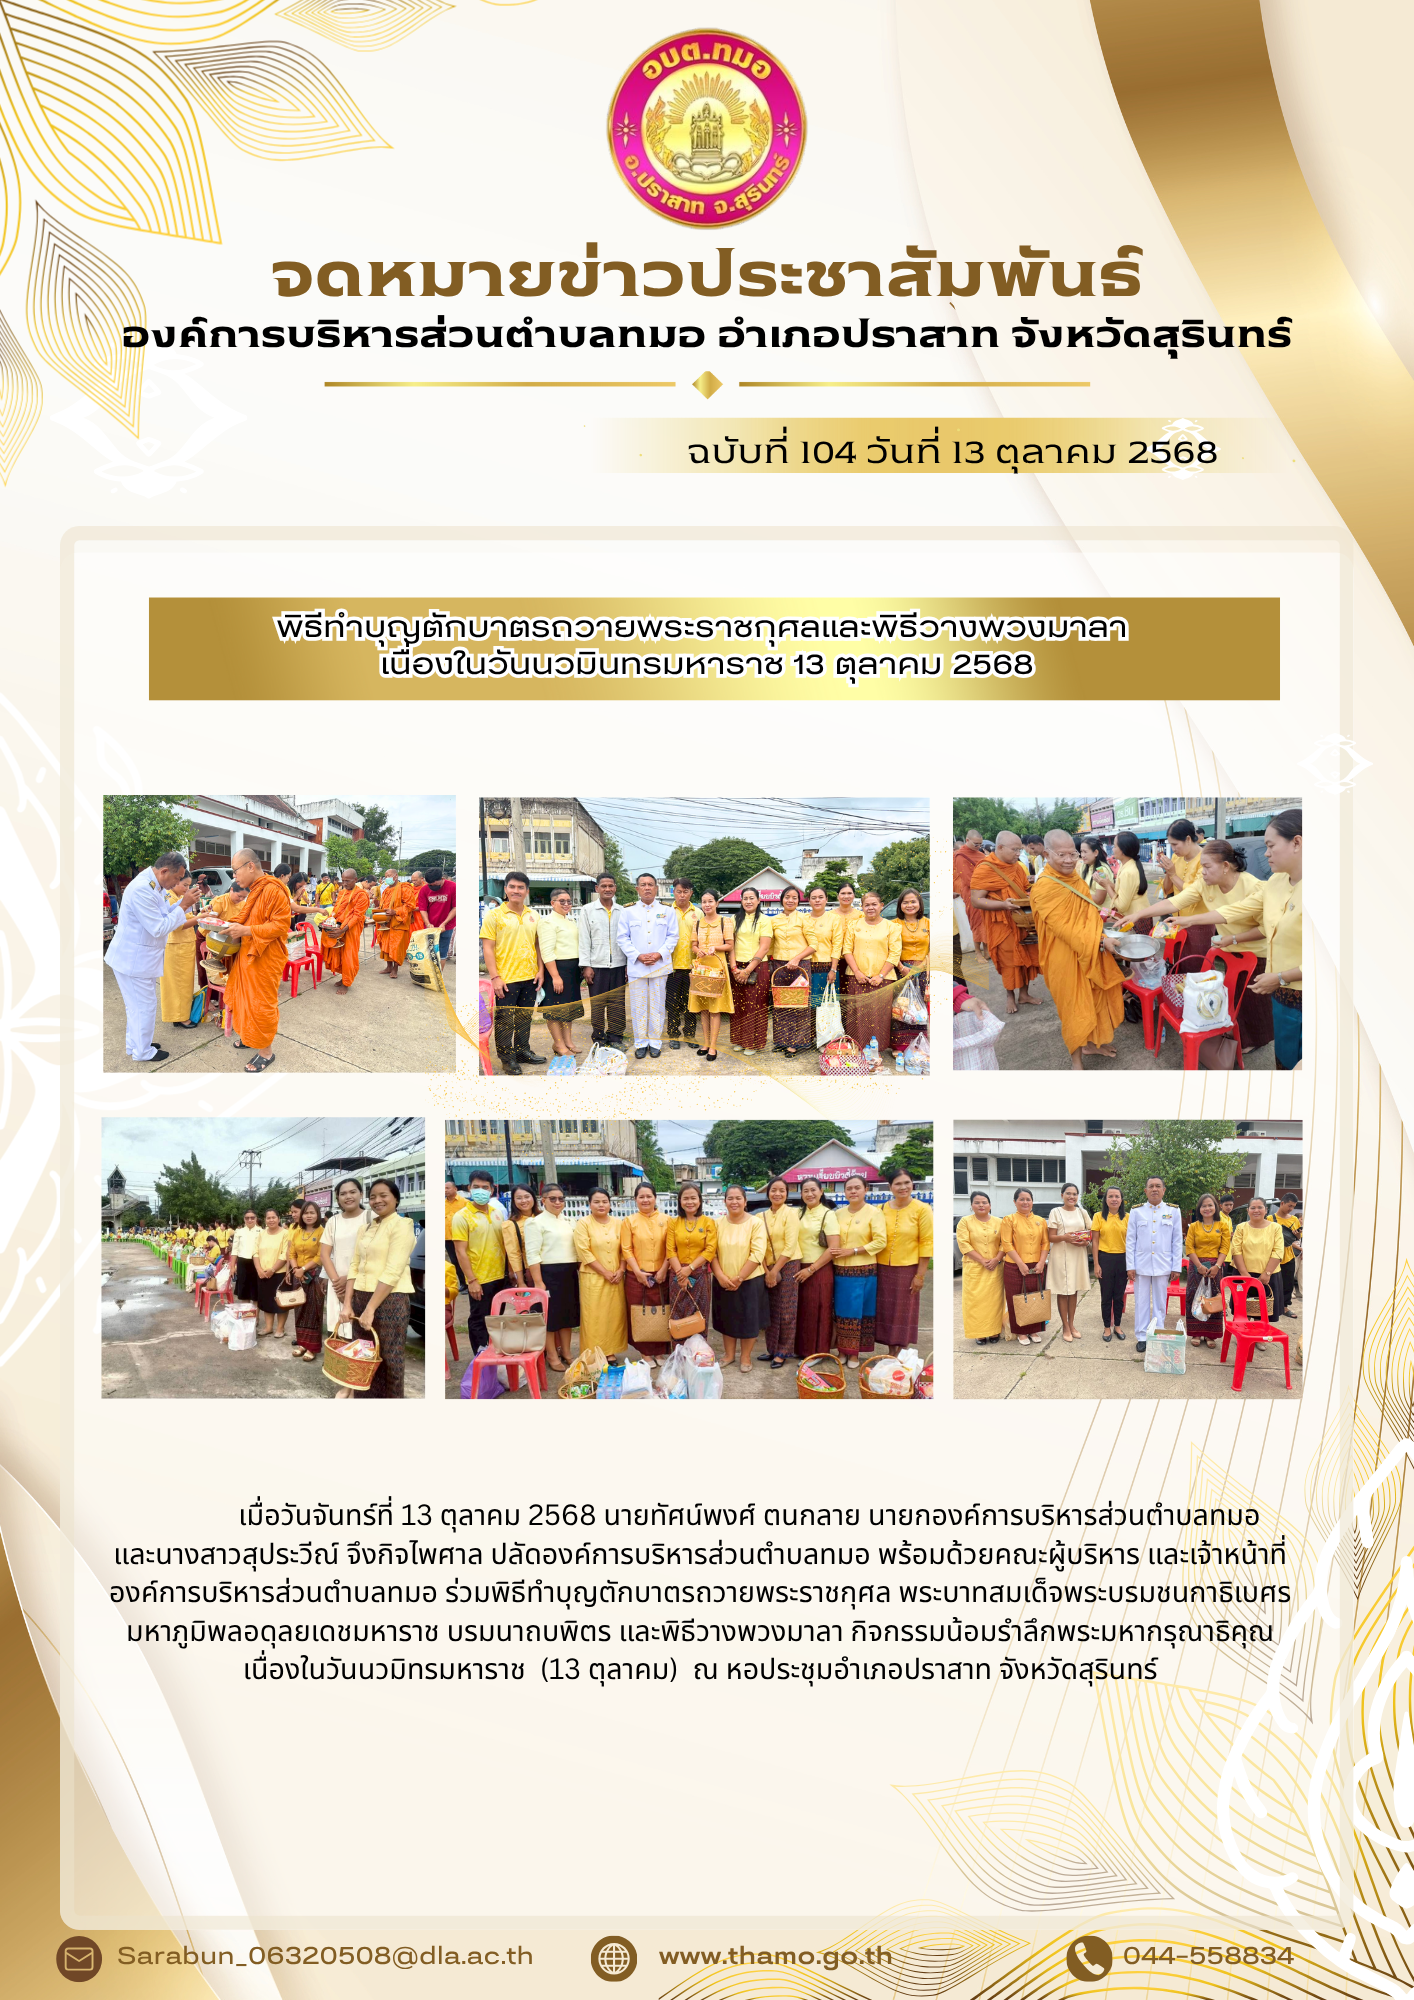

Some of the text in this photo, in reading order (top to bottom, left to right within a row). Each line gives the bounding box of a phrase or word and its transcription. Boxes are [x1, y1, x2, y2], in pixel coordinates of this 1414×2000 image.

[641, 41, 772, 80] อบต.ทมอ
[624, 153, 792, 215] อ.ปราสาท จ.สุรินทร์
[272, 242, 1143, 298] จดหมายข่าวประชาสัมพันธ์
[123, 314, 1293, 360] องค์การบริหารส่วนตำบลทมอ อำเภอปราสาท จังหวัดสุรินทร์
[688, 426, 1217, 474] ฉบับที่ 104 วันที่ 13 ตุลาคม 2568
[277, 611, 1126, 647] พิธีทำบุญตักบาตรถวายพระราชกุศลและพิธีวางพวงมาลา
[380, 645, 1033, 685] เนื่องในวันนวมินทรมหาราช 13 ตุลาคม 2568
[240, 1495, 1260, 1533] เมื่อวันจันทร์ที่ 13 ตุลาคม 2568 นายทัศน์พงศ์ ตนกลาย นายกองค์การบริหารส่วนตำบลทมอ
[115, 1535, 1286, 1572] และนางสาวสุประวีณ์ จึงกิจไพศาล ปลัดองค์การบริหารส่วนตำบลทมอ พร้อมด้วยคณะผู้บริหาร และเจ้าหน้าที่
[110, 1577, 1292, 1610] องค์การบริหารส่วนตำบลทมอ ร่วมพิธีทำบุญตักบาตรถวายพระราชกุศล พระบาทสมเด็จพระบรมชนกาธิเบศร
[127, 1616, 1273, 1649] มหาภูมิพลอดุลยเดชมหาราช บรมนาถบพิตร และพิธีวางพวงมาลา กิจกรรมน้อมรำลึกพระมหากรุณาธิคุณ
[244, 1649, 1159, 1687] เนื่องในวันนวมิทรมหาราช (13 ตุลาคม) ณ หอประชุมอำเภอปราสาท จังหวัดสุรินทร์
[117, 1945, 534, 1970] Sarabun_06320508@dla.ac.th
[658, 1945, 893, 1971] www.thamo.go.th
[1123, 1946, 1295, 1965] 044-558834
